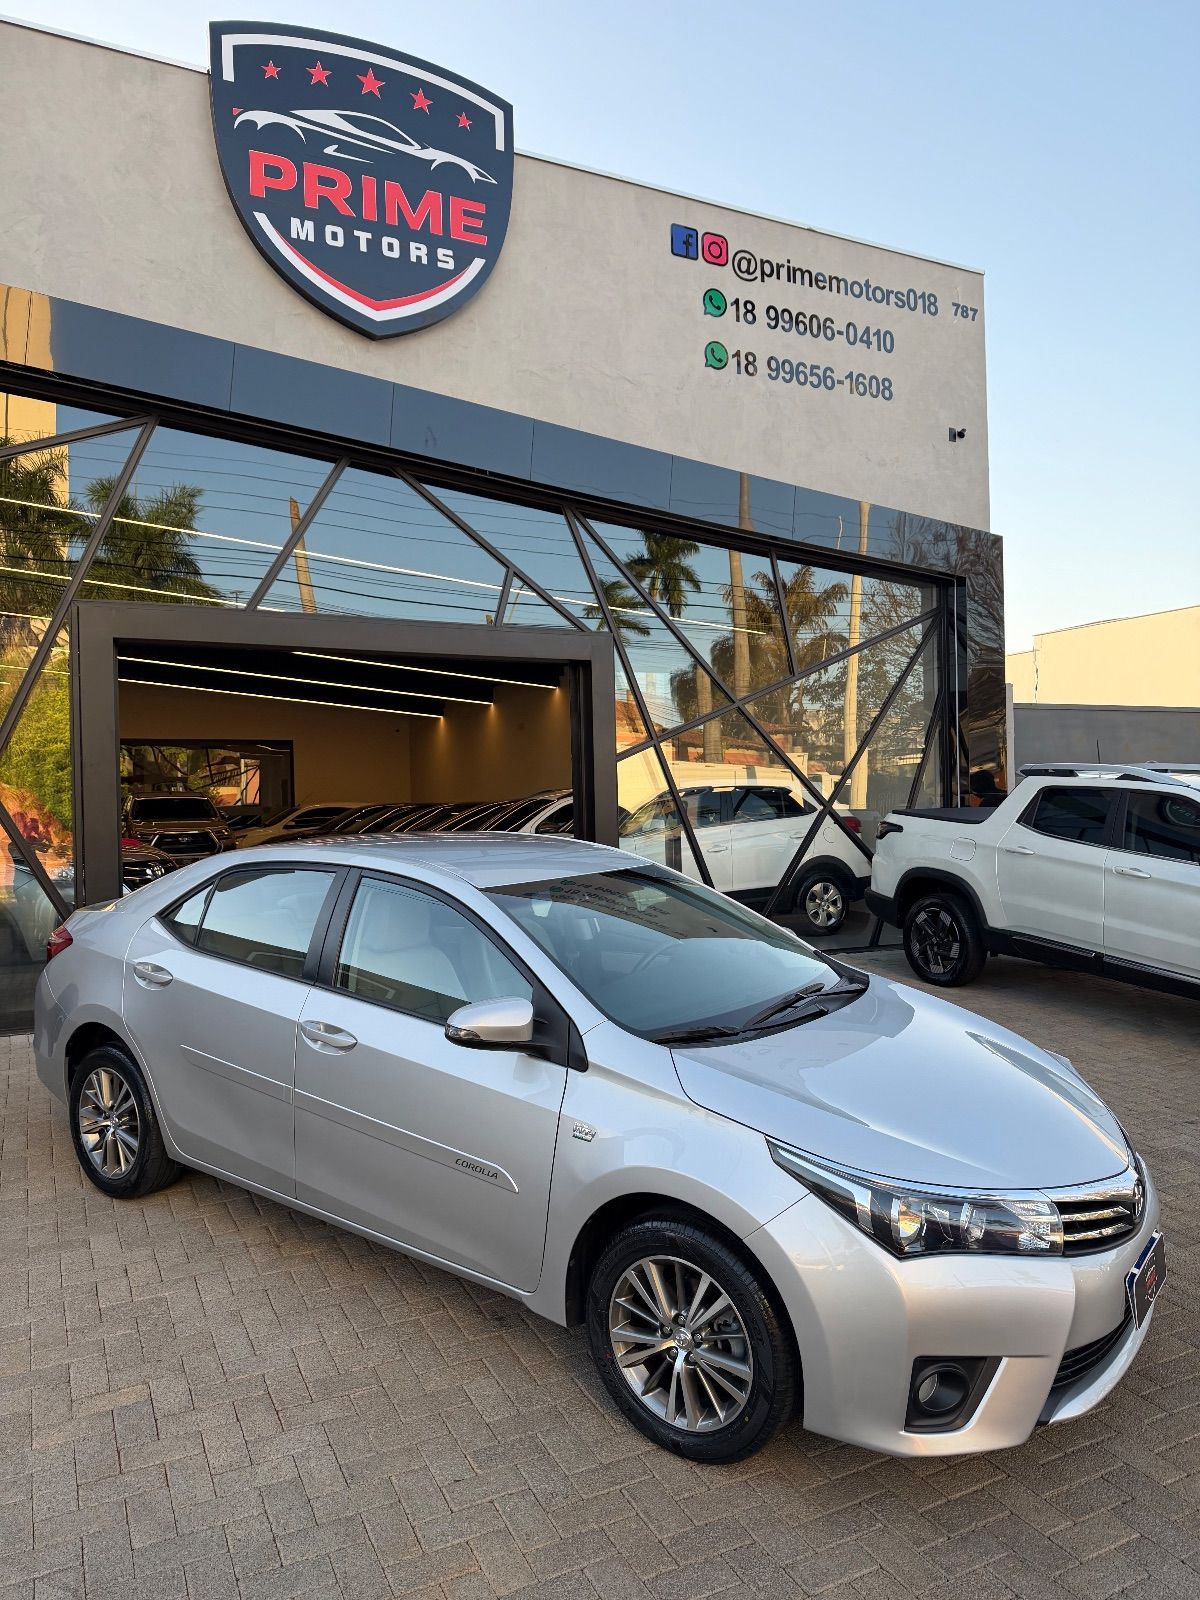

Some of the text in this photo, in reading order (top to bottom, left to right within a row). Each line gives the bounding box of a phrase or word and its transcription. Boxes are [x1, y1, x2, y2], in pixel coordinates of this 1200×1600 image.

[249, 149, 487, 246] PRIME
[290, 217, 454, 270] MOTORS
[732, 250, 939, 316] @primemotors018
[730, 298, 895, 354] 18 99606-0410
[952, 302, 978, 322] 787
[731, 350, 893, 401] 18 99656-1608
[455, 1158, 498, 1180] COROLLA
